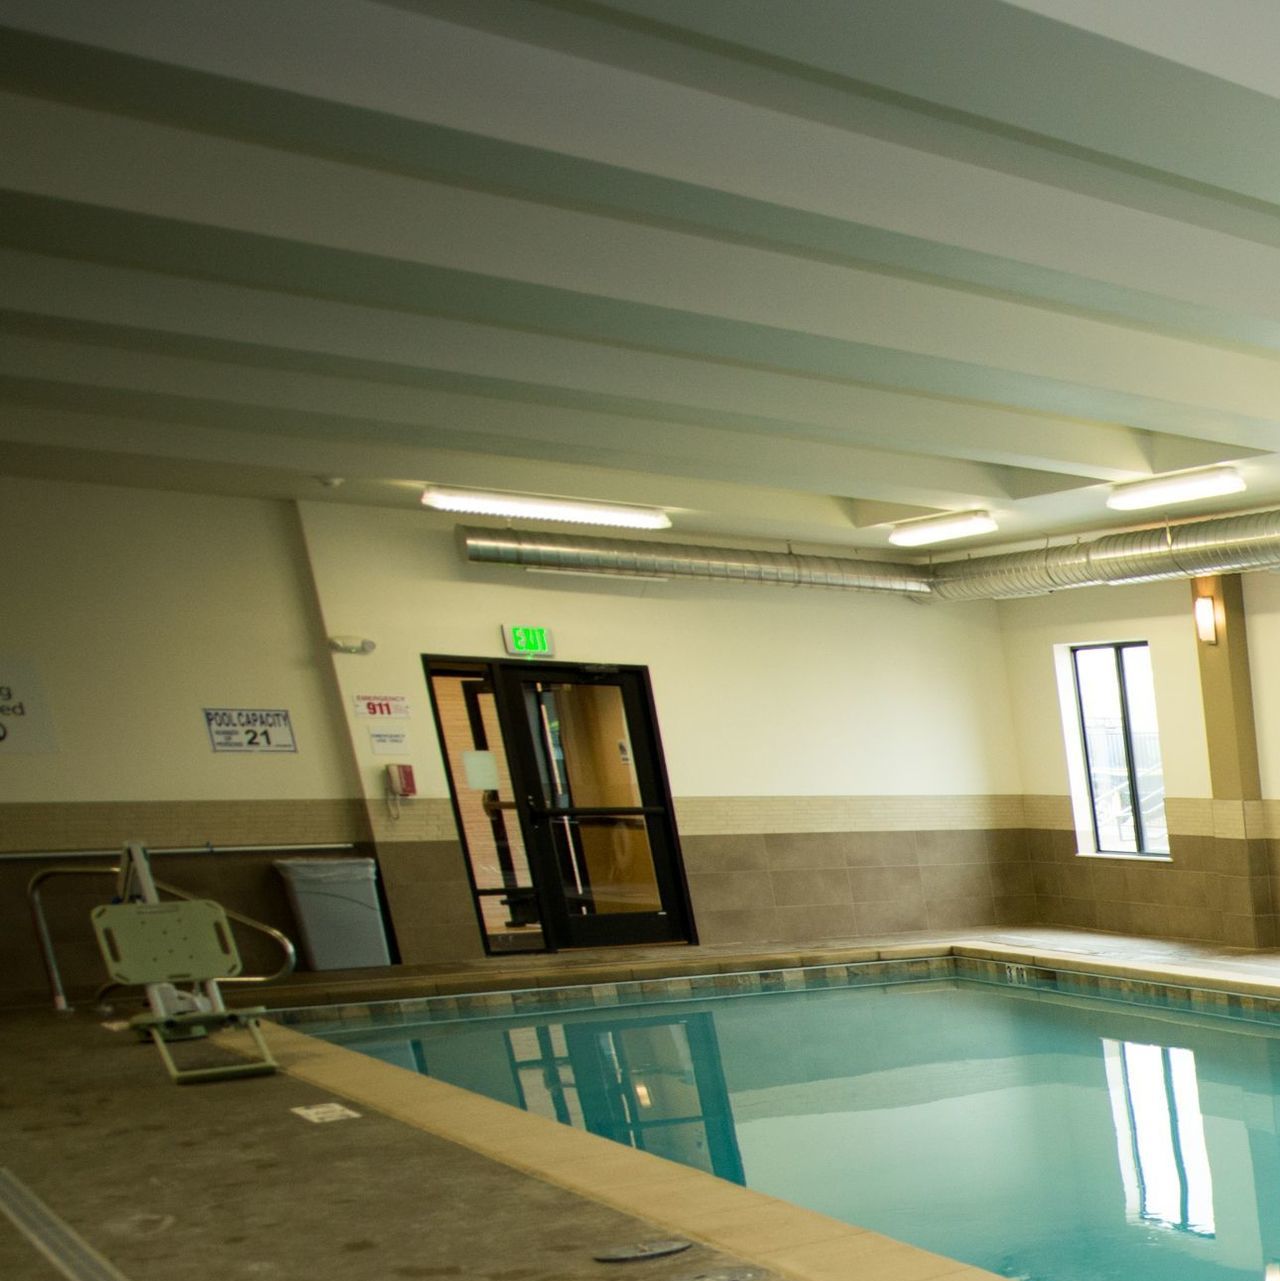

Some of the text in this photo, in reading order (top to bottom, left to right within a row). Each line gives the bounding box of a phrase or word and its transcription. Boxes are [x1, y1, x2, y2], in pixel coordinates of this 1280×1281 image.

[512, 627, 547, 652] EXIT
[366, 702, 392, 715] 911
[205, 711, 290, 729] POOL CAPACITY
[244, 728, 272, 747] 21
